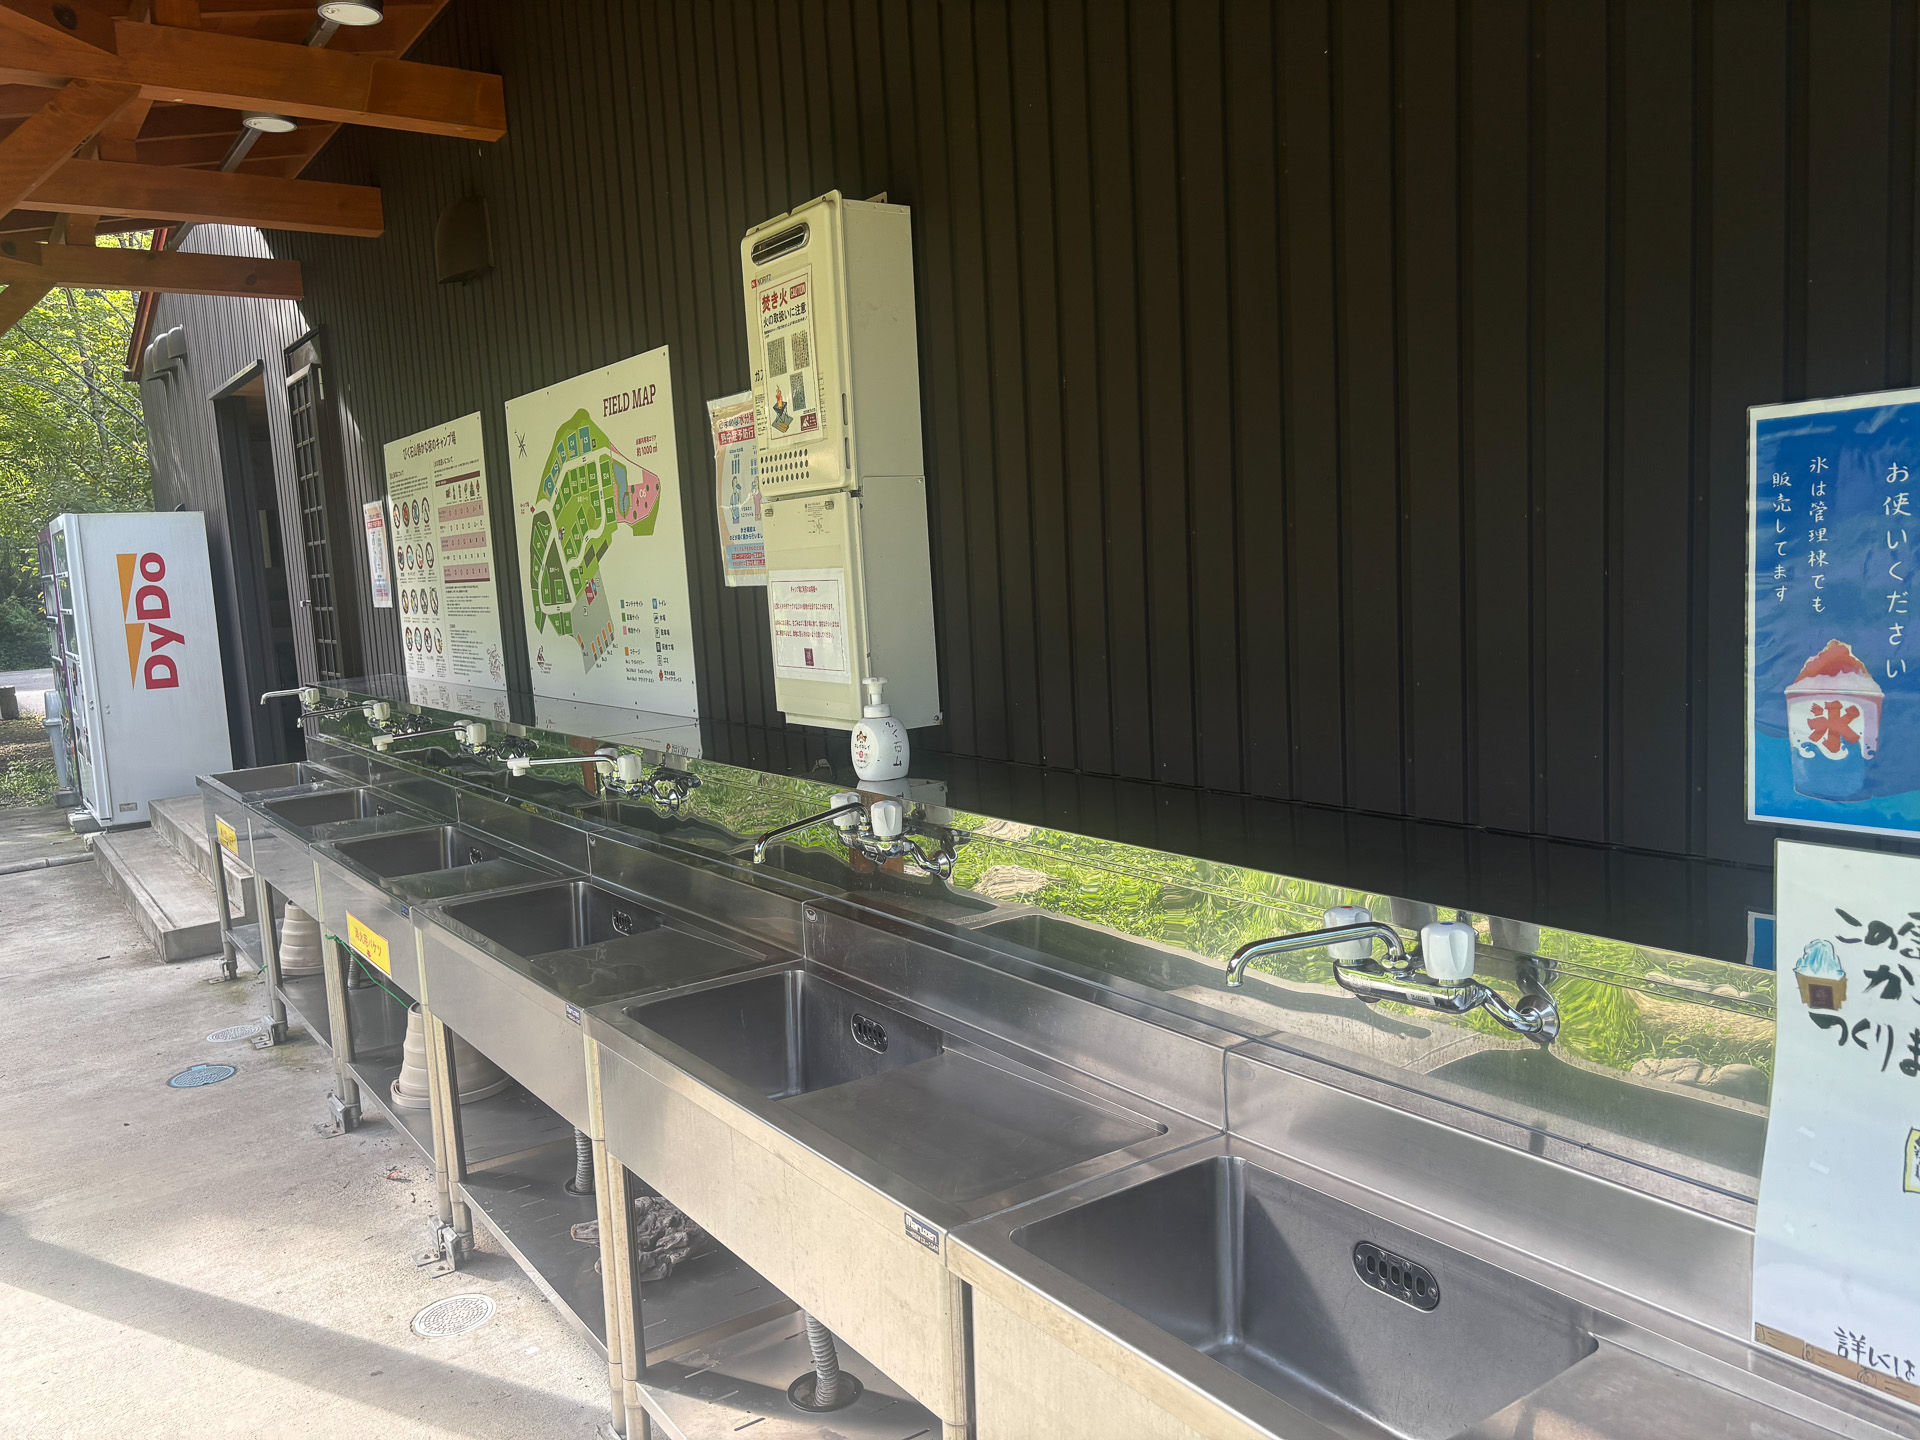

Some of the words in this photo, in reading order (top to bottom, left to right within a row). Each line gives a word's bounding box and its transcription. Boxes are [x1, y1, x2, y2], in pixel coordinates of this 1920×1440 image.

[761, 287, 788, 315] 焚き火
[763, 302, 807, 329] 火の取扱いに注意
[603, 392, 630, 418] FIELD
[632, 383, 657, 410] MAP
[1772, 472, 1792, 602] 販売してます
[1807, 456, 1829, 613] 氷は管理棟でも
[1883, 462, 1912, 678] お使いください
[136, 552, 185, 690] DyDo
[1807, 700, 1861, 754] 氷
[1833, 1326, 1915, 1381] 詳しくは
